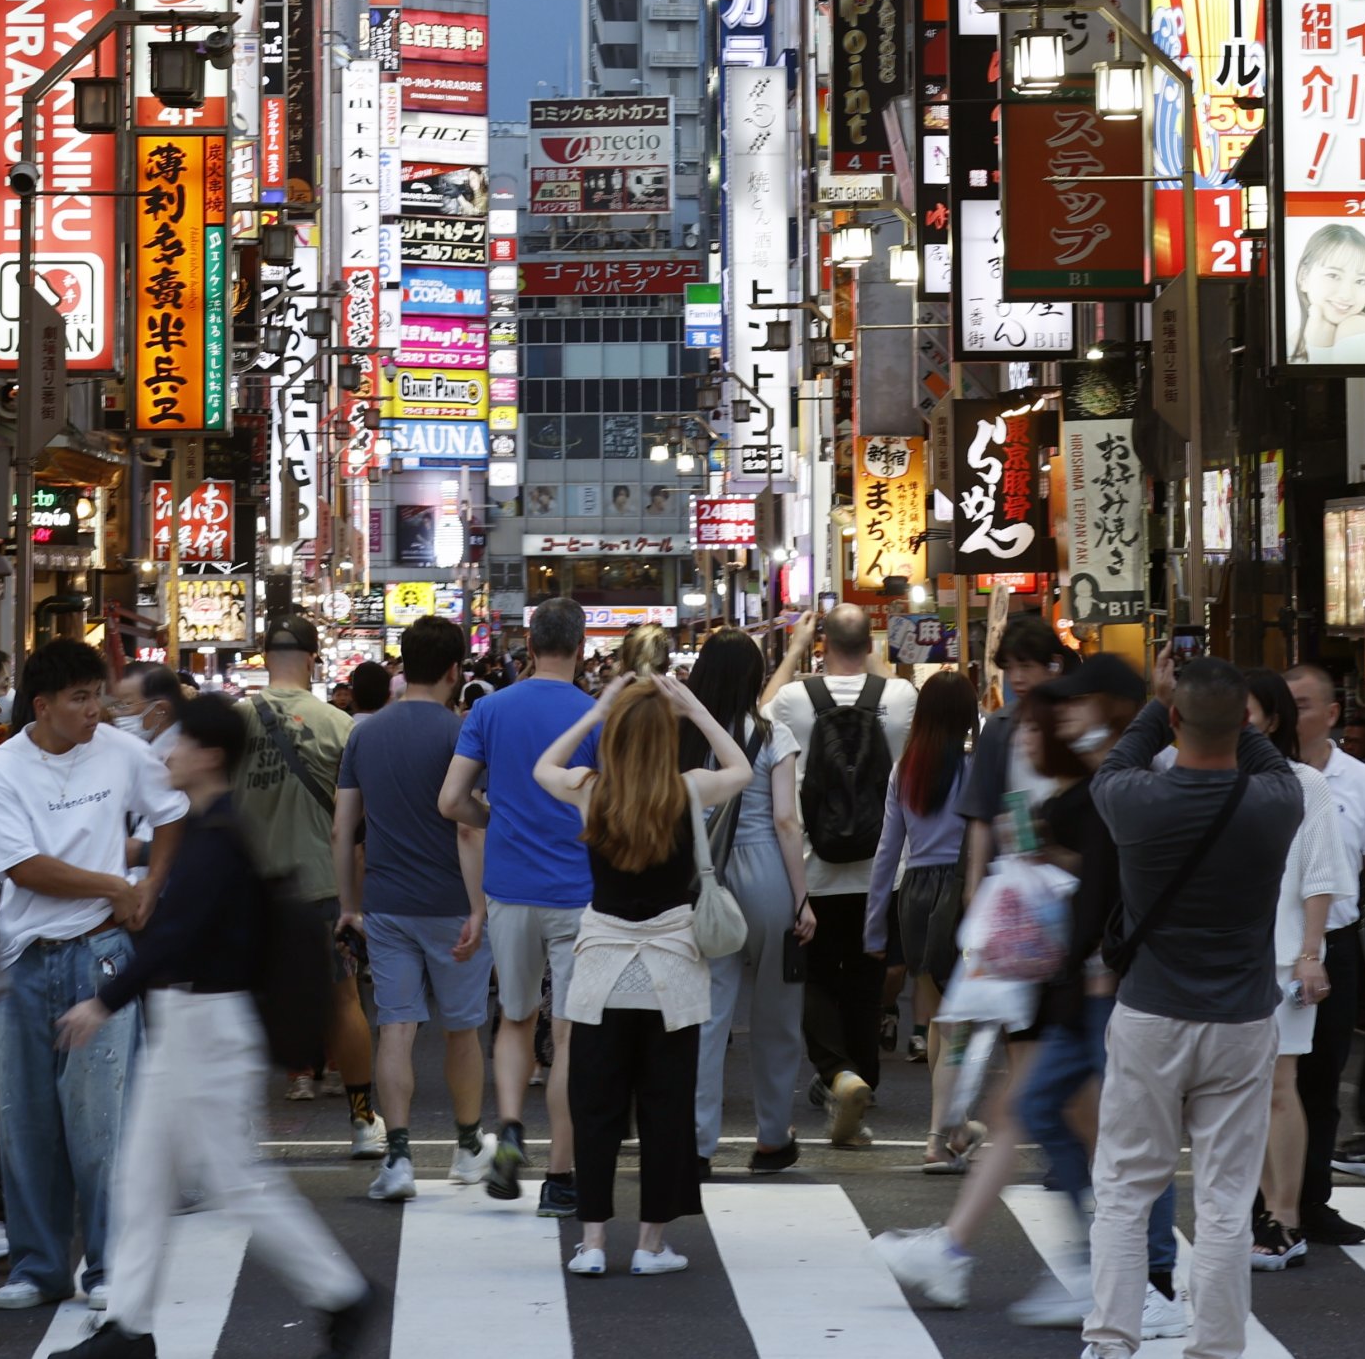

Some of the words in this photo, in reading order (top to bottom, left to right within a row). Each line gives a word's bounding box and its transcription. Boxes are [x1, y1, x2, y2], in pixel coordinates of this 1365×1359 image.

[157, 107, 204, 126] 4F
[533, 104, 668, 122] コミック&ネットカフェ
[401, 124, 485, 143] FACE
[596, 152, 659, 162] アプレシオ
[206, 144, 225, 214] 炭火串焼
[1045, 108, 1112, 267] ステップ
[820, 186, 846, 200] MEAT
[847, 186, 883, 200] GARDEN
[573, 279, 649, 293] ハンバーグ
[1068, 272, 1091, 286] B1
[1033, 332, 1071, 349] B1F
[1161, 309, 1179, 404] 劇場通り一番街
[401, 374, 432, 398] GAME
[392, 423, 488, 455] SAUNA
[1002, 415, 1033, 521] 東京豚骨
[1070, 433, 1084, 499] HIROSHIMA
[699, 503, 756, 521] 24時間
[1091, 431, 1140, 576] お好み焼き
[699, 524, 756, 542] 営業中
[865, 481, 896, 577] まっちゃん
[1073, 497, 1089, 565] TEPPANYAKI
[541, 537, 594, 553] コーヒー
[635, 536, 673, 553] クール
[1108, 600, 1145, 617] B1F
[47, 789, 109, 812] balenciaga
